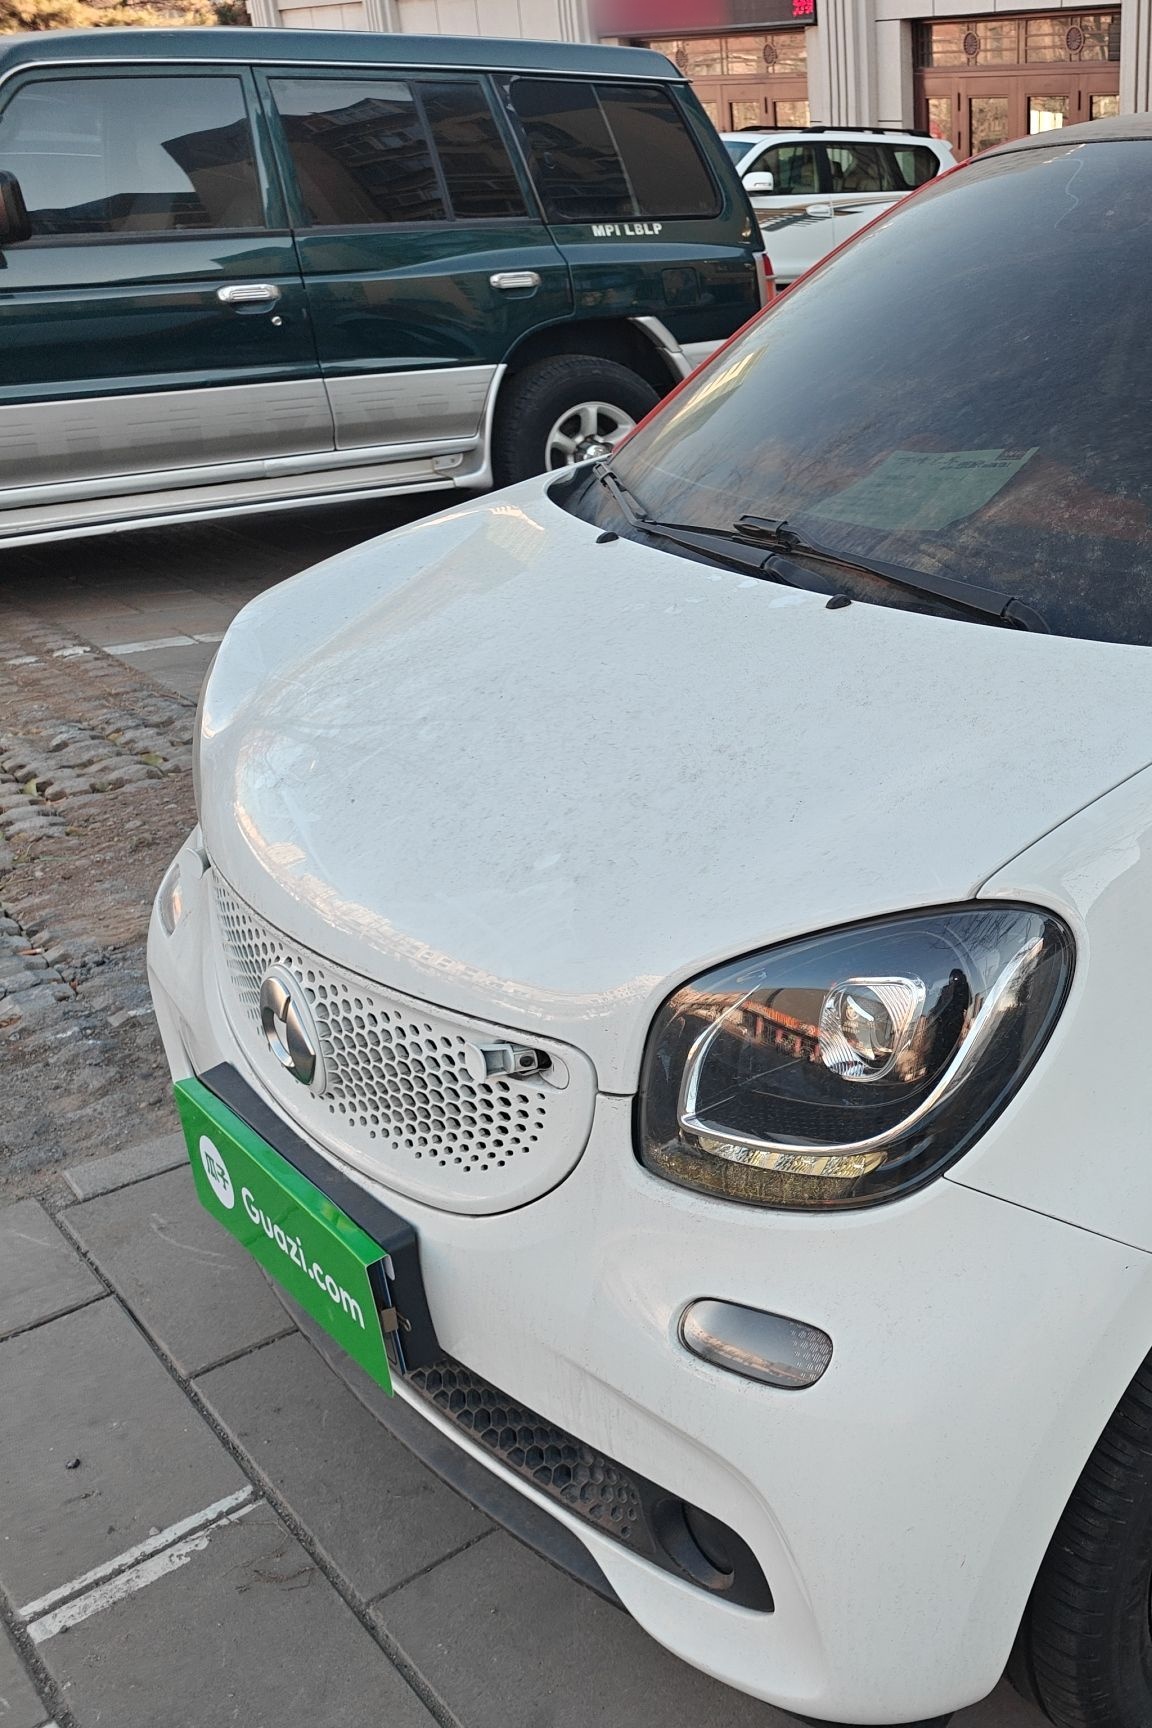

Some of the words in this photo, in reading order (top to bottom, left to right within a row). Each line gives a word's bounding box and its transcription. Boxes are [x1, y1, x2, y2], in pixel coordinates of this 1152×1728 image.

[591, 223, 621, 237] MPI
[204, 1151, 230, 1191] 瓜子
[241, 1187, 365, 1330] Guazi.com
